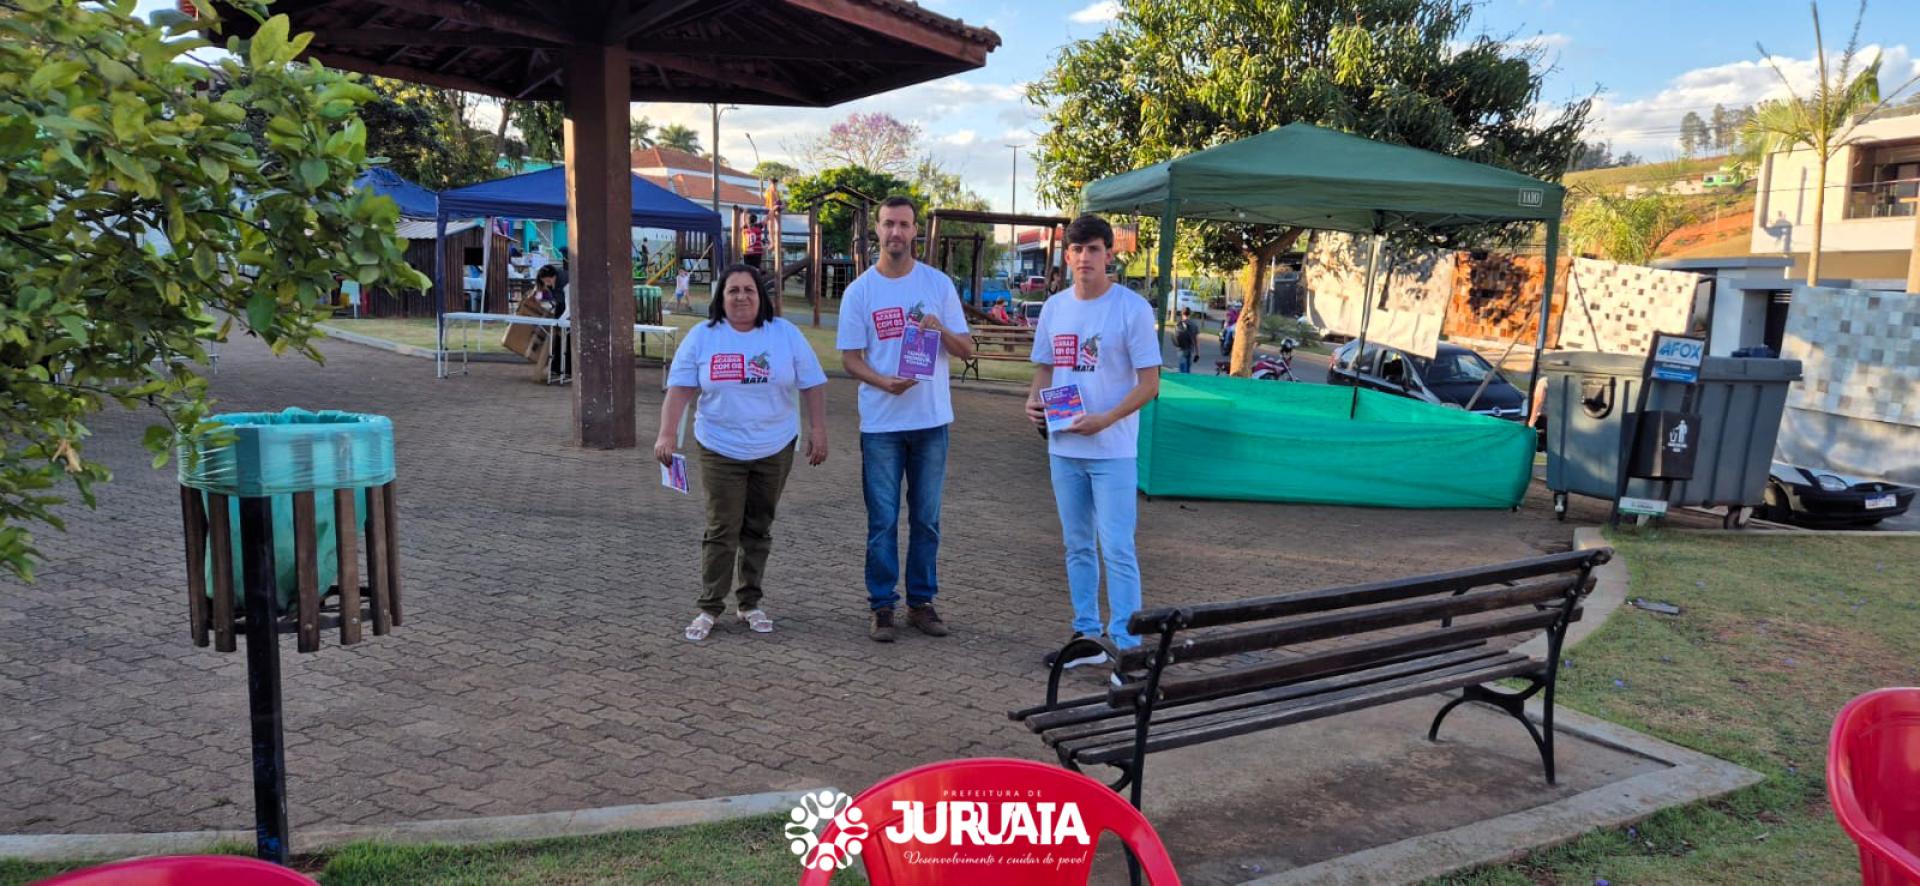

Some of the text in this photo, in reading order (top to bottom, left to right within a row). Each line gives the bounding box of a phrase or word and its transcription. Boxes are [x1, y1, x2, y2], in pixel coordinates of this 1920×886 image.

[877, 318, 903, 329] COM OS
[1659, 341, 1702, 360] AFOX
